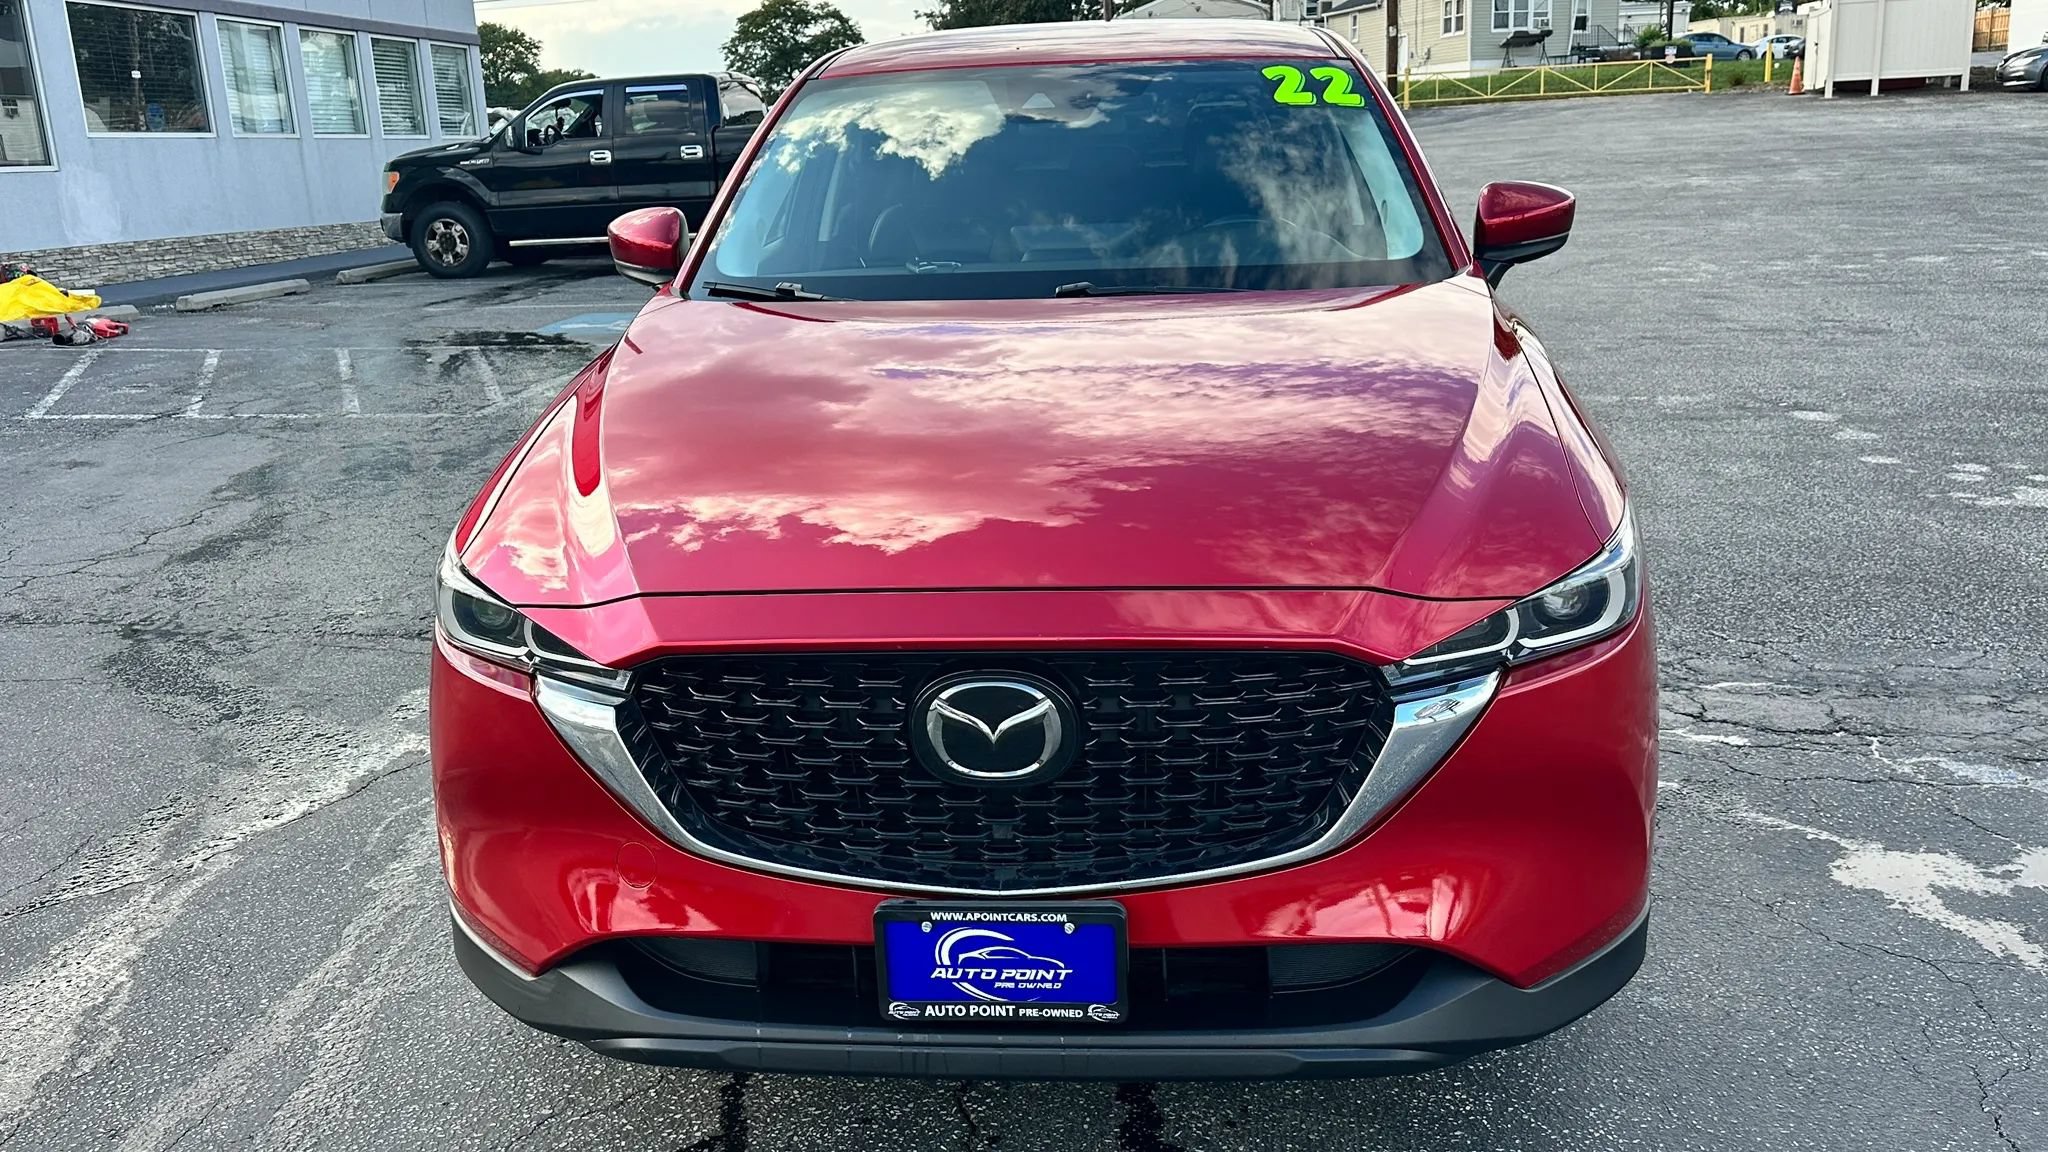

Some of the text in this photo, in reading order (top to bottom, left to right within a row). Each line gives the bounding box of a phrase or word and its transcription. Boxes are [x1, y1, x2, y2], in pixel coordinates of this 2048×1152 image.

[1260, 64, 1366, 107] 22
[930, 911, 1068, 922] WWW.APOINTCARS.COM
[930, 967, 1073, 981] AUTO POINT
[925, 1005, 1084, 1018] AUTO POINT PRE-OWNED
